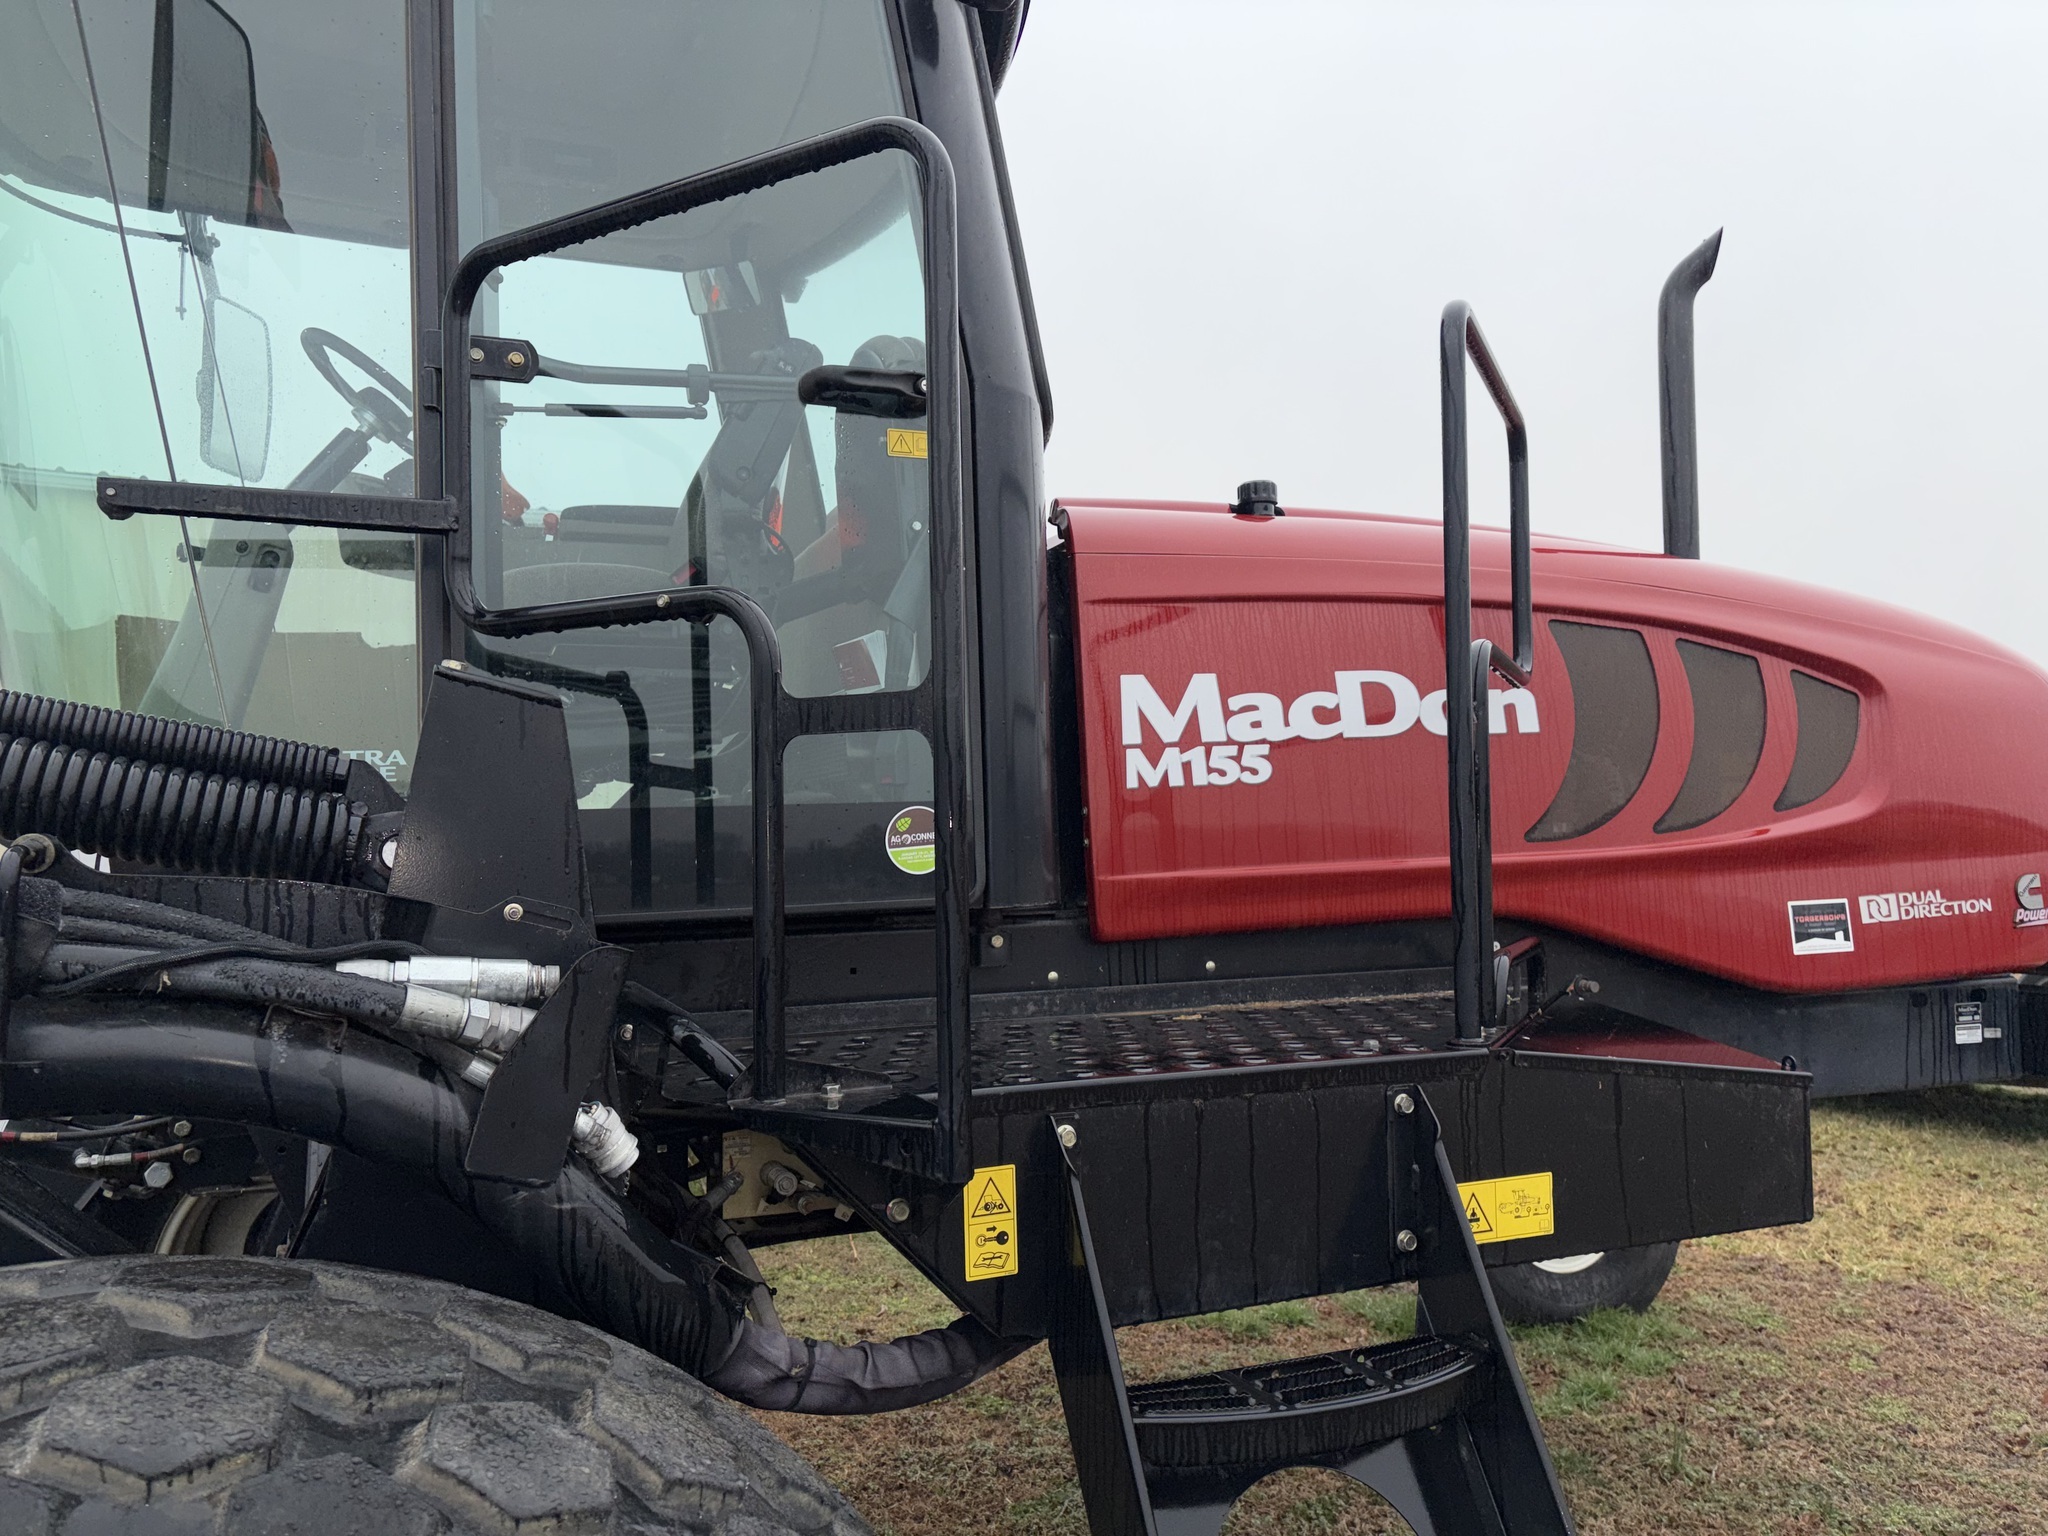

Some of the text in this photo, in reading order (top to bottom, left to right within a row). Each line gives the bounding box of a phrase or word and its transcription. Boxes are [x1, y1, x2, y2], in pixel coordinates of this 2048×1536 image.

[1125, 743, 1273, 789] M155
[890, 835, 901, 843] AG
[1898, 889, 1947, 906] DUAL
[1901, 898, 1993, 920] DIRECTION
